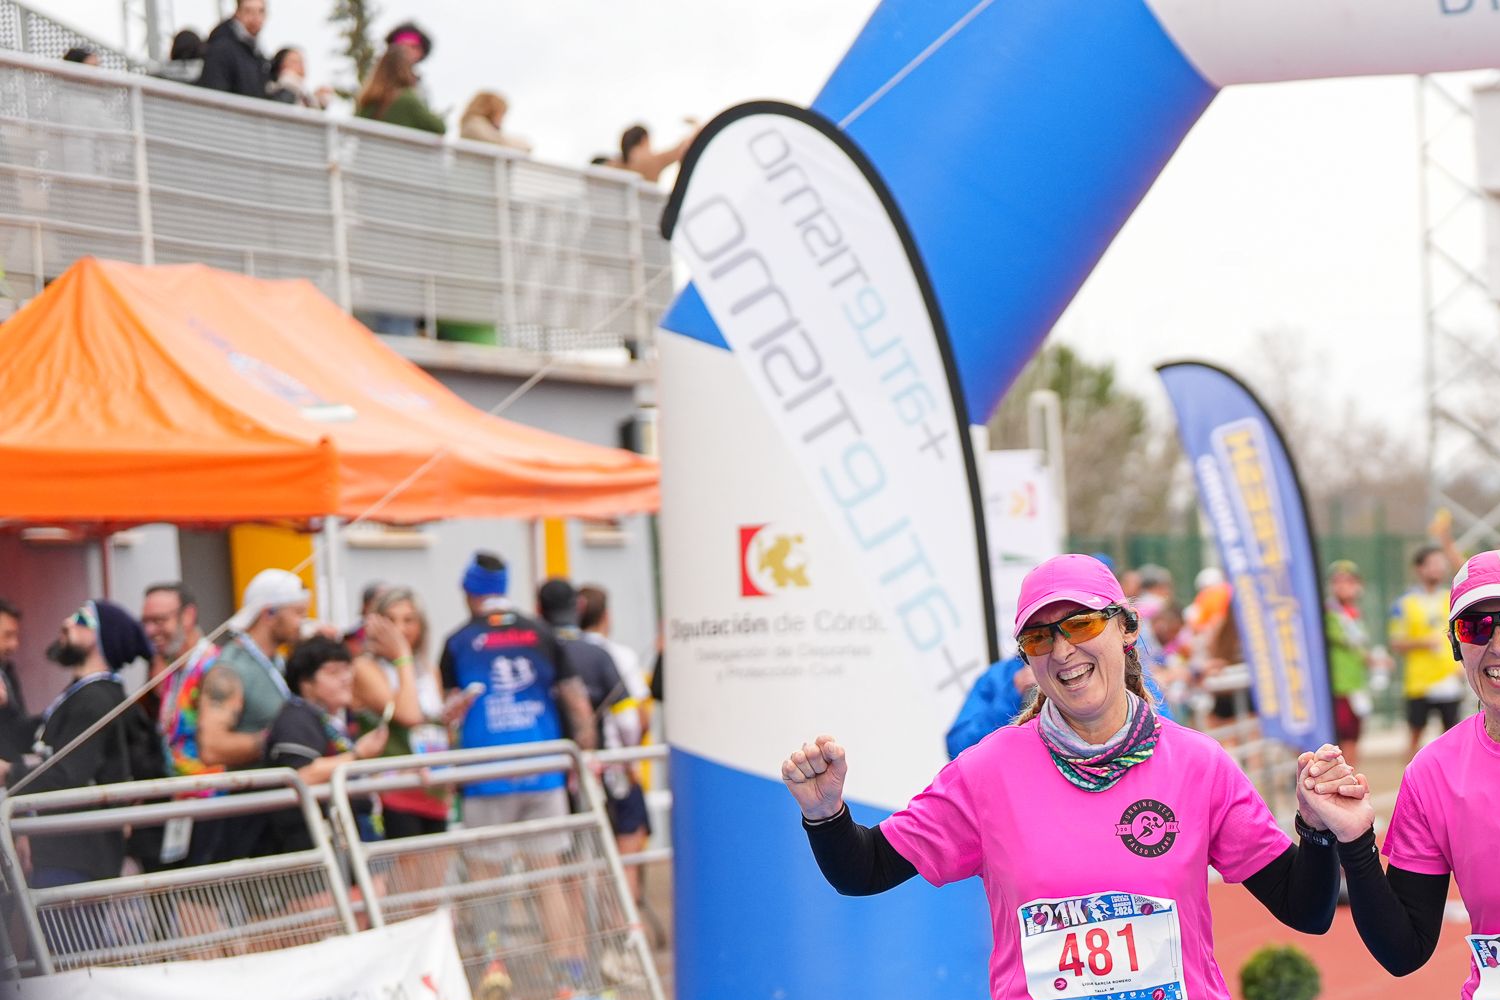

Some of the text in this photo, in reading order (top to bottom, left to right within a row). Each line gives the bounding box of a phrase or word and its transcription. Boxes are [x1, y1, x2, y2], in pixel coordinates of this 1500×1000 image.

[1122, 801, 1153, 824] RUNNING
[1127, 836, 1171, 855] FALSO LLANO
[1114, 905, 1133, 917] 2026
[1058, 923, 1139, 977] 481
